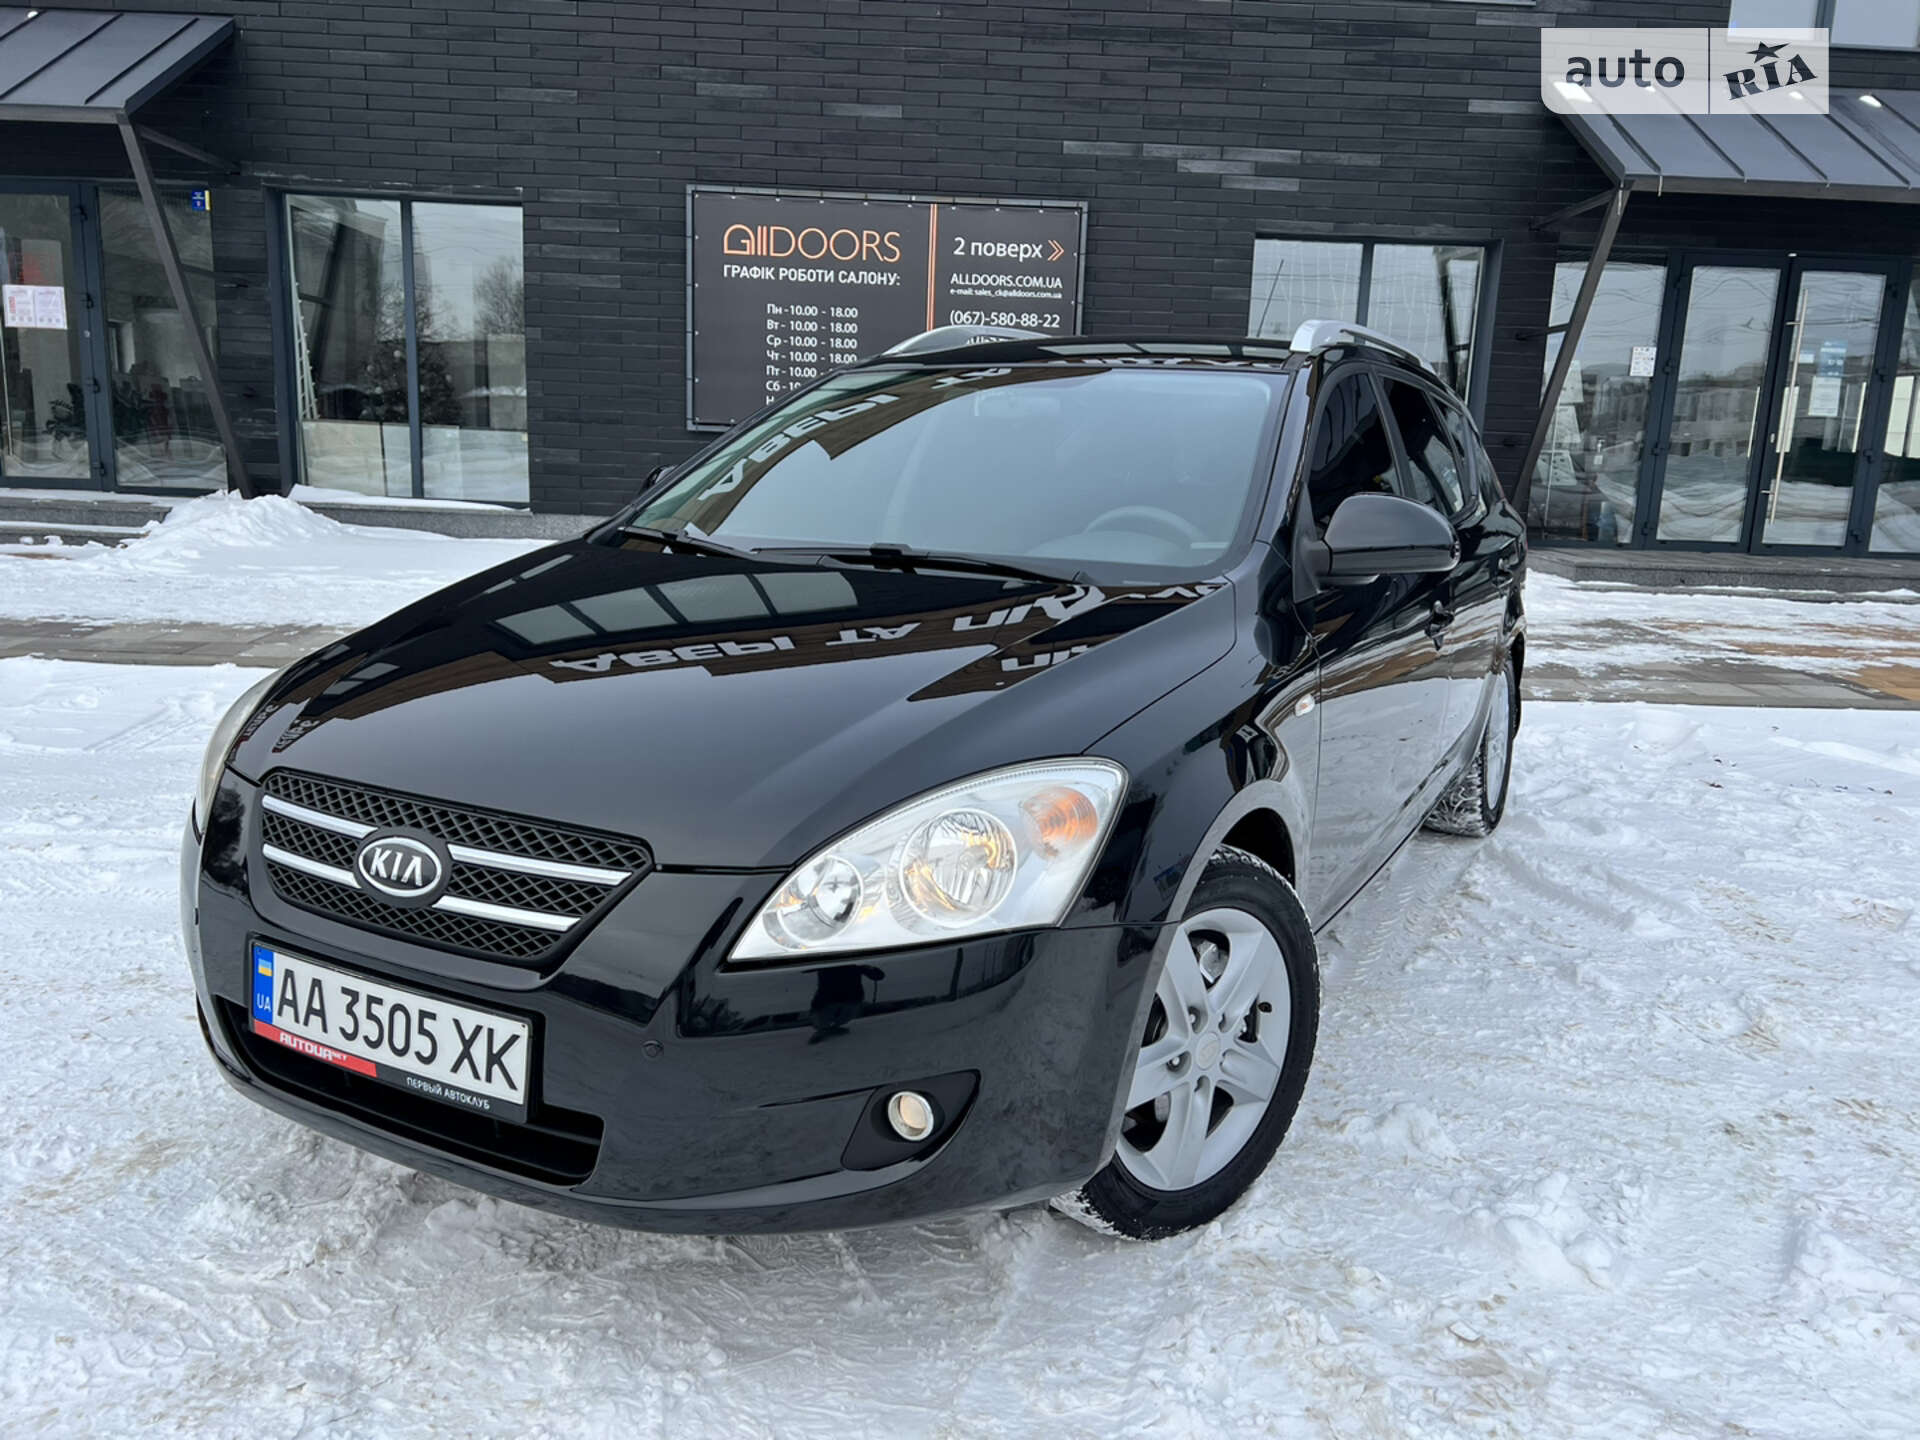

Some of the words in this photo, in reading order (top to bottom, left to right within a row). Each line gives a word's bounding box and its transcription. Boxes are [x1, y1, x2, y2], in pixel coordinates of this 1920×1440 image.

[953, 236, 965, 255] 2
[970, 241, 1043, 262] поверх
[723, 264, 775, 280] ГРАФІК
[779, 267, 834, 283] РОБОТИ
[838, 270, 901, 286] САЛОНУ:
[950, 273, 1063, 288] ALLDOORS.COM.UA
[767, 303, 782, 314] Пн
[830, 307, 858, 318] 18.00
[766, 319, 779, 330] Вт
[790, 320, 818, 332] 10.00
[830, 322, 858, 334] 18.00
[950, 310, 1060, 328] (067)-580-88-22
[766, 334, 781, 348] Ср
[829, 338, 857, 349] 18.00
[766, 350, 779, 361] Чт
[789, 351, 817, 363] 10.00
[829, 353, 857, 364] 18.00
[766, 365, 779, 376] Пт
[788, 366, 817, 378] 10.00
[765, 380, 781, 392] Сб
[370, 847, 423, 886] KIA
[256, 993, 272, 1013] UA
[277, 968, 328, 1034] AA
[339, 986, 438, 1065] 3505
[450, 1018, 521, 1091] XK
[406, 1076, 442, 1096] ПЕРВЫЙ
[444, 1088, 490, 1110] АВТОКЛУБ
